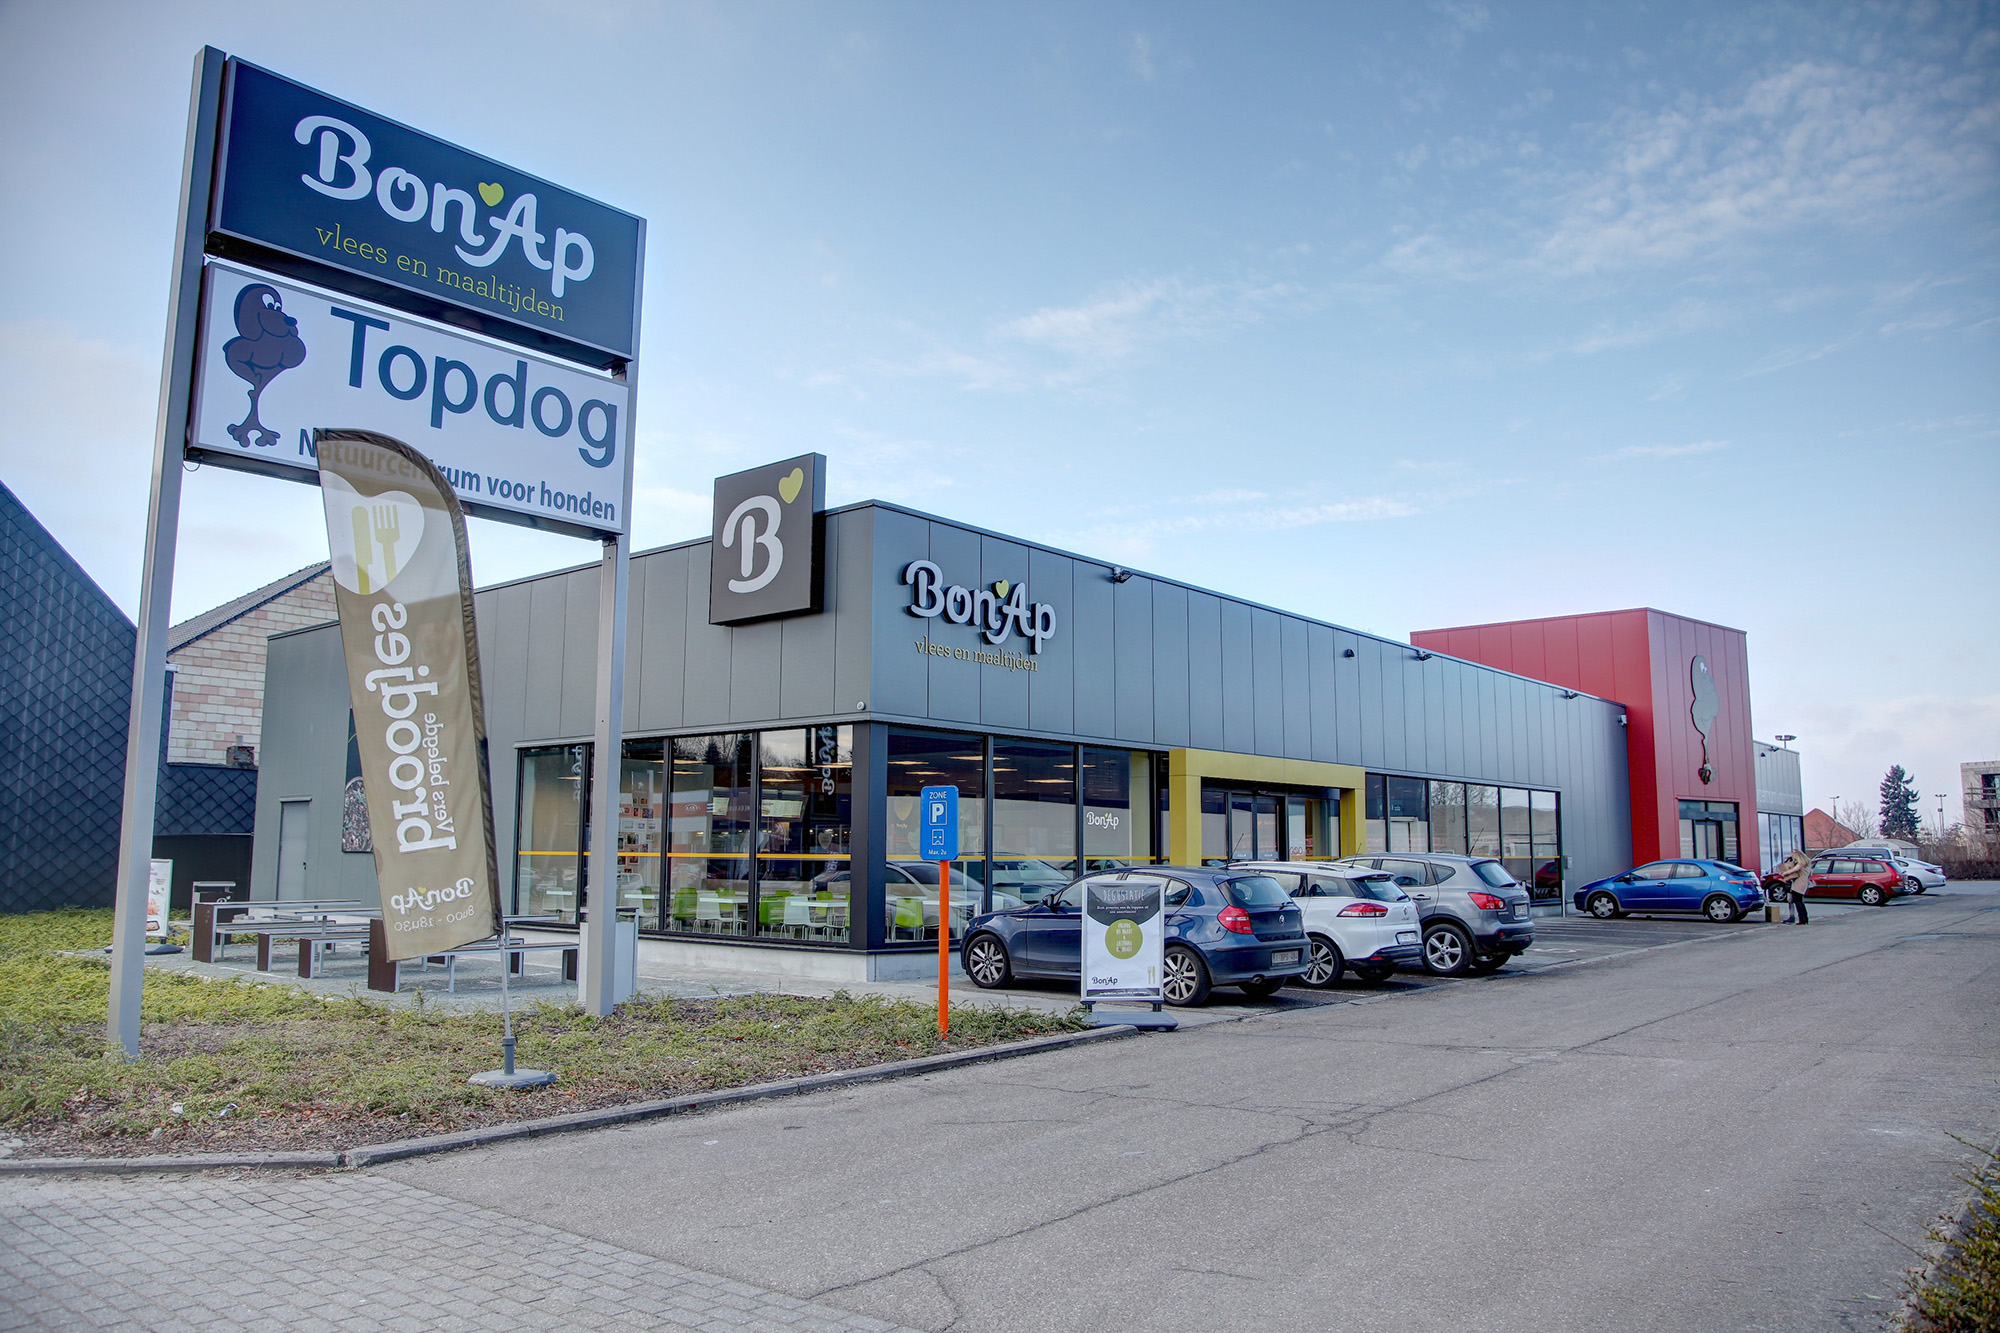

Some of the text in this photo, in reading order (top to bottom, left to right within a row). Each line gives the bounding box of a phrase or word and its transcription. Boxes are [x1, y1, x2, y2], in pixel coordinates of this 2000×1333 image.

[315, 222, 566, 322] vlees en maaltijden
[330, 306, 618, 469] Topdog
[299, 427, 616, 522] Natuurcenrum voor honden
[721, 494, 785, 595] B
[915, 635, 1038, 673] vlees en maaltijden
[929, 791, 947, 799] ZONE
[932, 804, 944, 822] P
[1103, 890, 1145, 901] DEGUSTATIE
